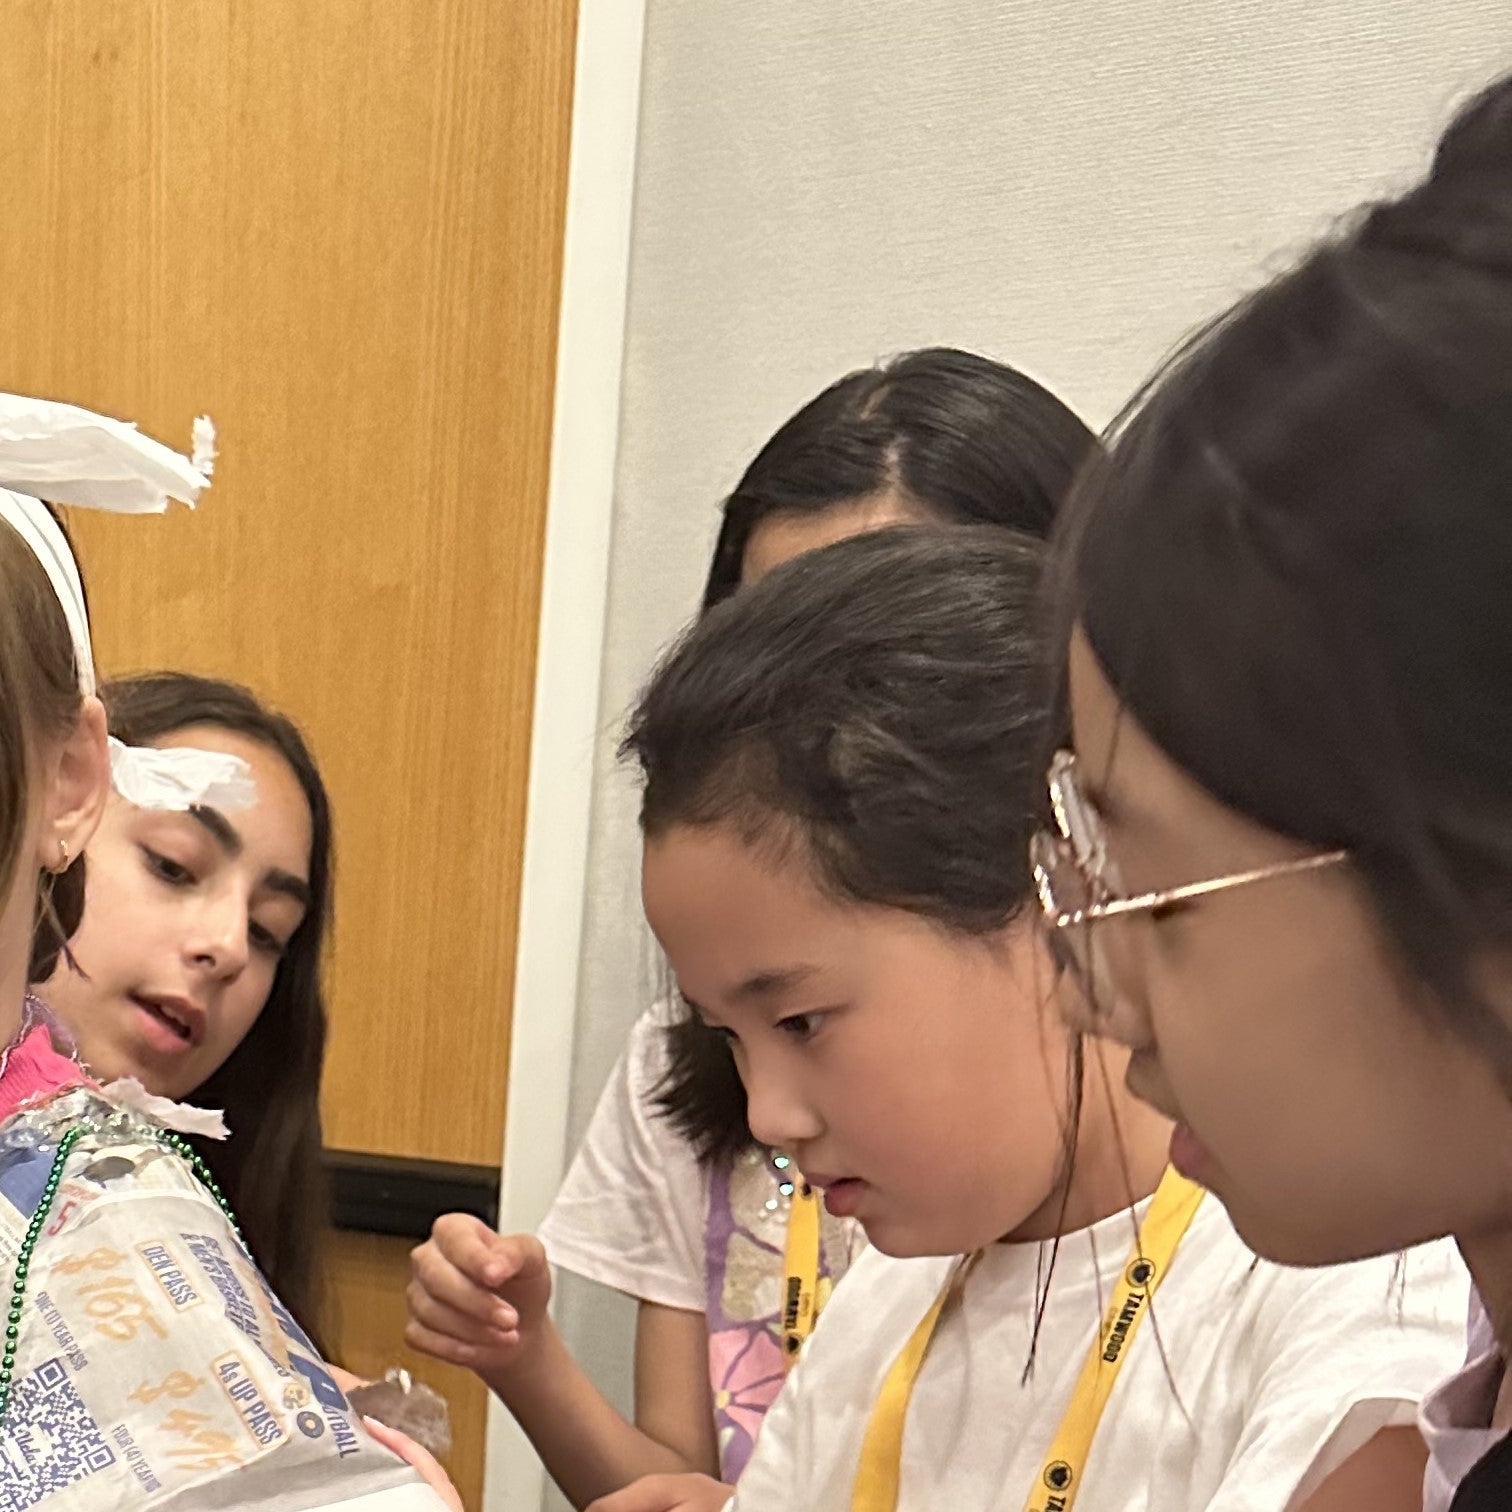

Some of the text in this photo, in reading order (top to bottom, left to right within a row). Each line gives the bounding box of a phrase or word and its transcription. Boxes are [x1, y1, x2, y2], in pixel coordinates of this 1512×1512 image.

[144, 1246, 198, 1305] DEN PASS
[51, 1320, 74, 1350] YEAR
[229, 1377, 257, 1404] UP
[243, 1400, 282, 1446] PASS
